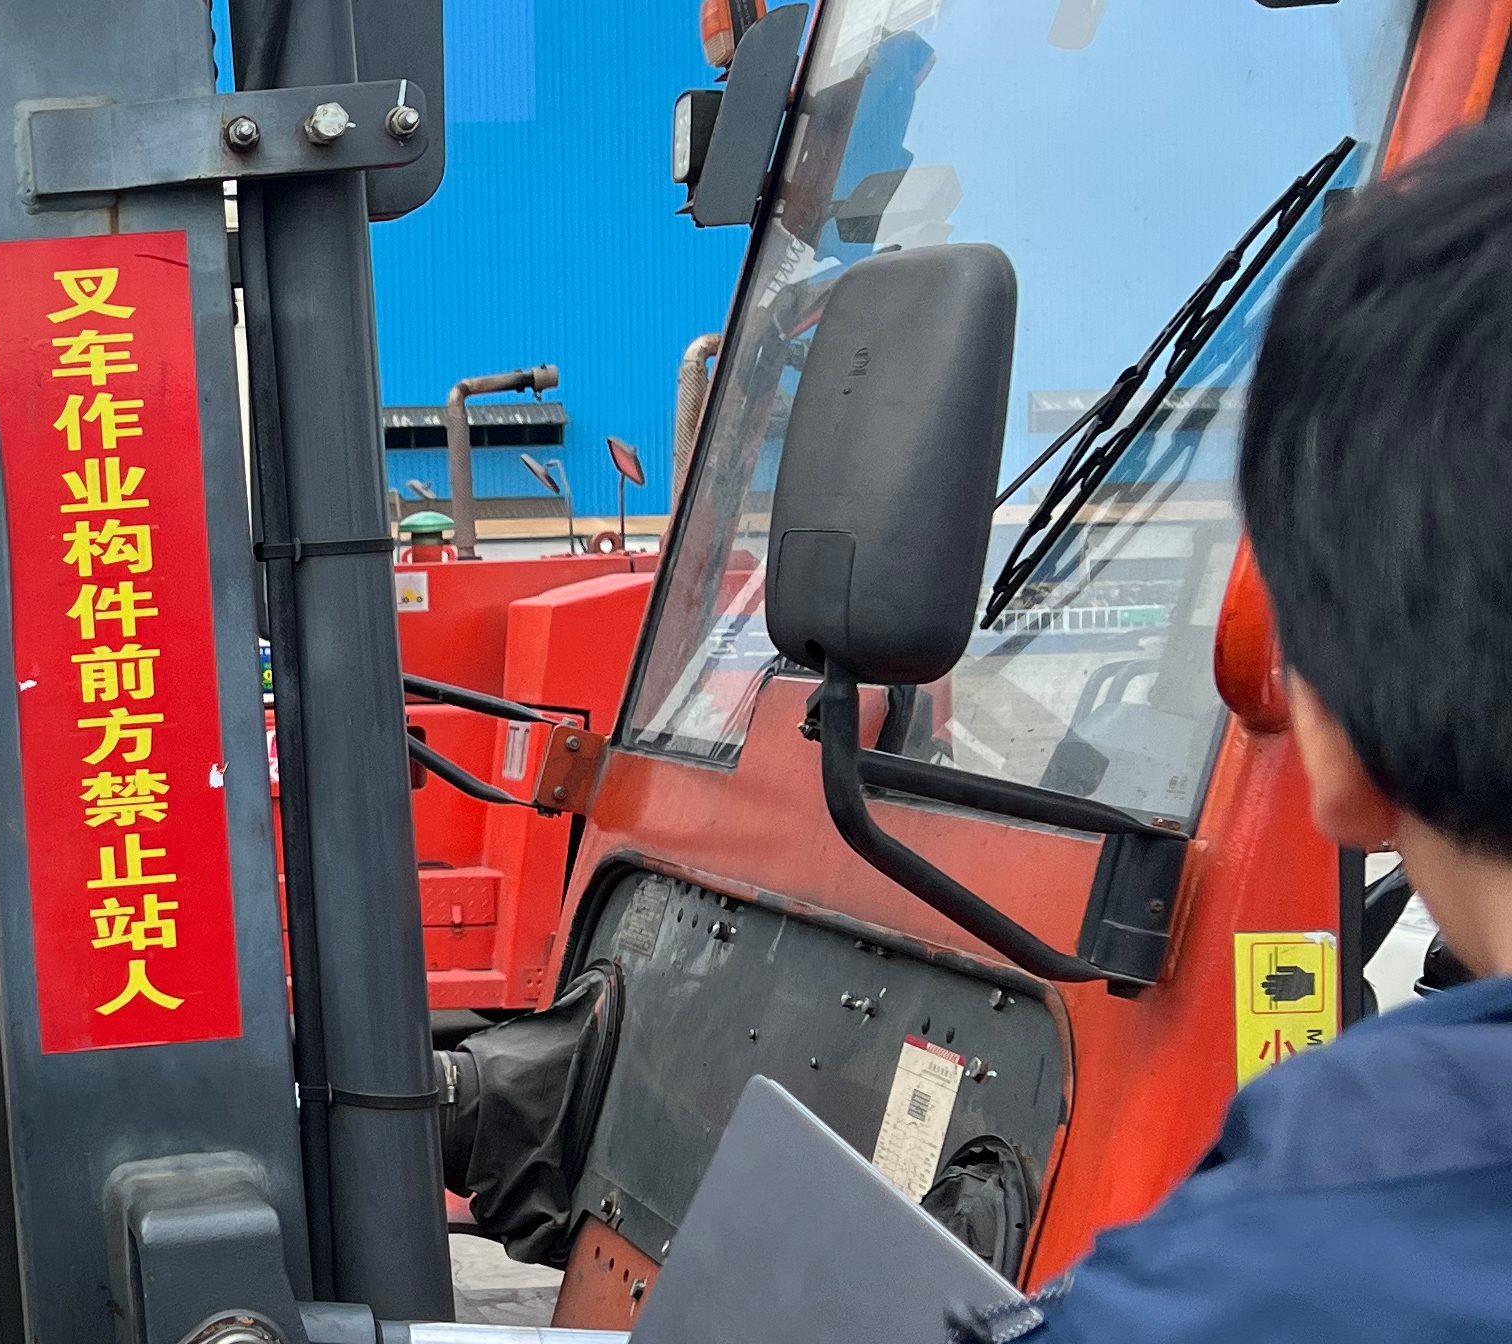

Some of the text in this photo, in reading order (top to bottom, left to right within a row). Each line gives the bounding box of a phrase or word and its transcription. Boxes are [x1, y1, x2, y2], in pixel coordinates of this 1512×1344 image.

[46, 268, 186, 1016] 叉车作业构件前方禁止站人
